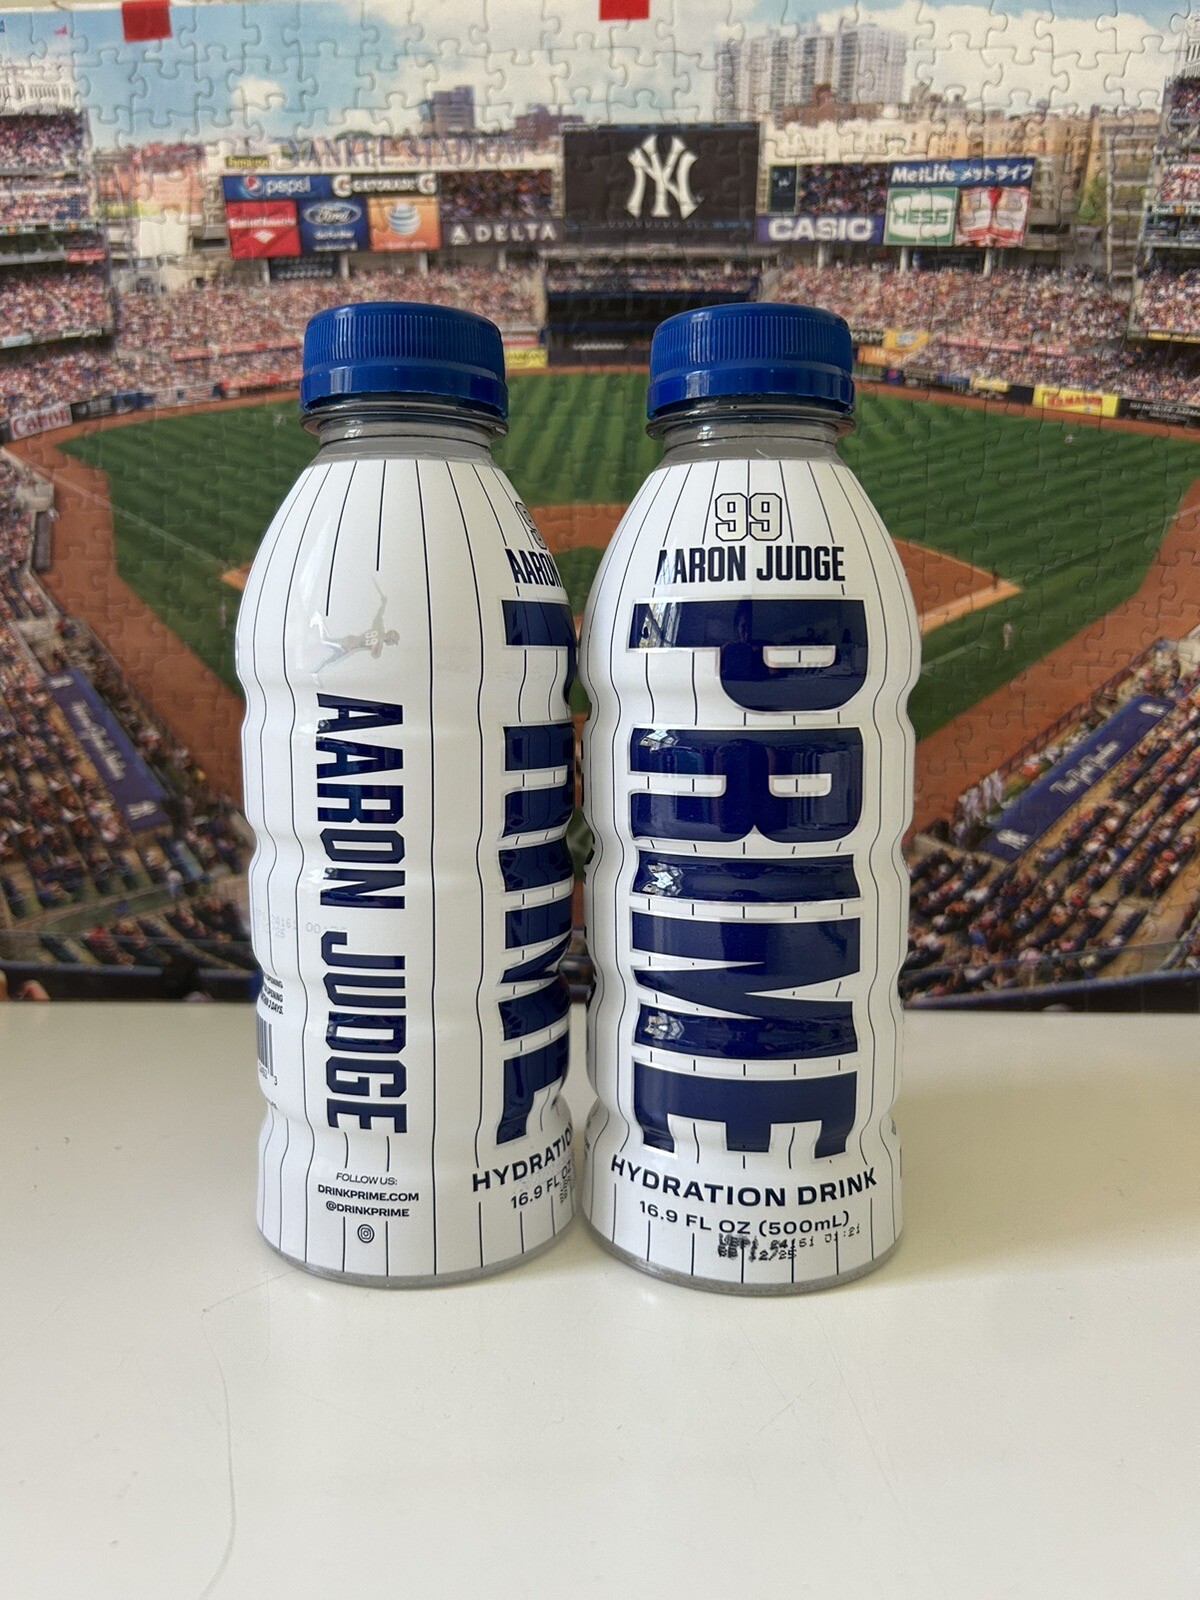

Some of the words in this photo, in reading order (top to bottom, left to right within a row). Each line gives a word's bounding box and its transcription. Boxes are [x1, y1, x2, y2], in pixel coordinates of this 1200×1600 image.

[265, 177, 311, 197] pepsi
[891, 164, 957, 183] MetLife
[314, 206, 351, 223] Ford
[767, 217, 873, 241] CASIO
[893, 209, 949, 225] HESS
[474, 222, 557, 243] DELTA
[715, 493, 782, 541] 99
[654, 546, 747, 584] AARON
[756, 545, 846, 583] JUDGE
[316, 692, 405, 910] AARON
[626, 598, 869, 1159] PRIME
[320, 930, 407, 1133] JUDGE
[472, 1121, 573, 1192] HYDRATIO
[318, 1184, 420, 1202] DRINKPRIME.COM
[336, 1172, 378, 1185] FOLLOW
[379, 1177, 398, 1186] US:
[511, 1185, 543, 1209] 16.9
[546, 1174, 560, 1192] FL
[611, 1153, 786, 1208] HYDRATION
[797, 1166, 878, 1206] DRINK
[325, 1200, 410, 1217] @DRINKPRIME
[640, 1200, 678, 1224] 16.9
[686, 1213, 712, 1231] FL
[719, 1219, 751, 1235] OZ
[758, 1210, 850, 1237] (500mL)
